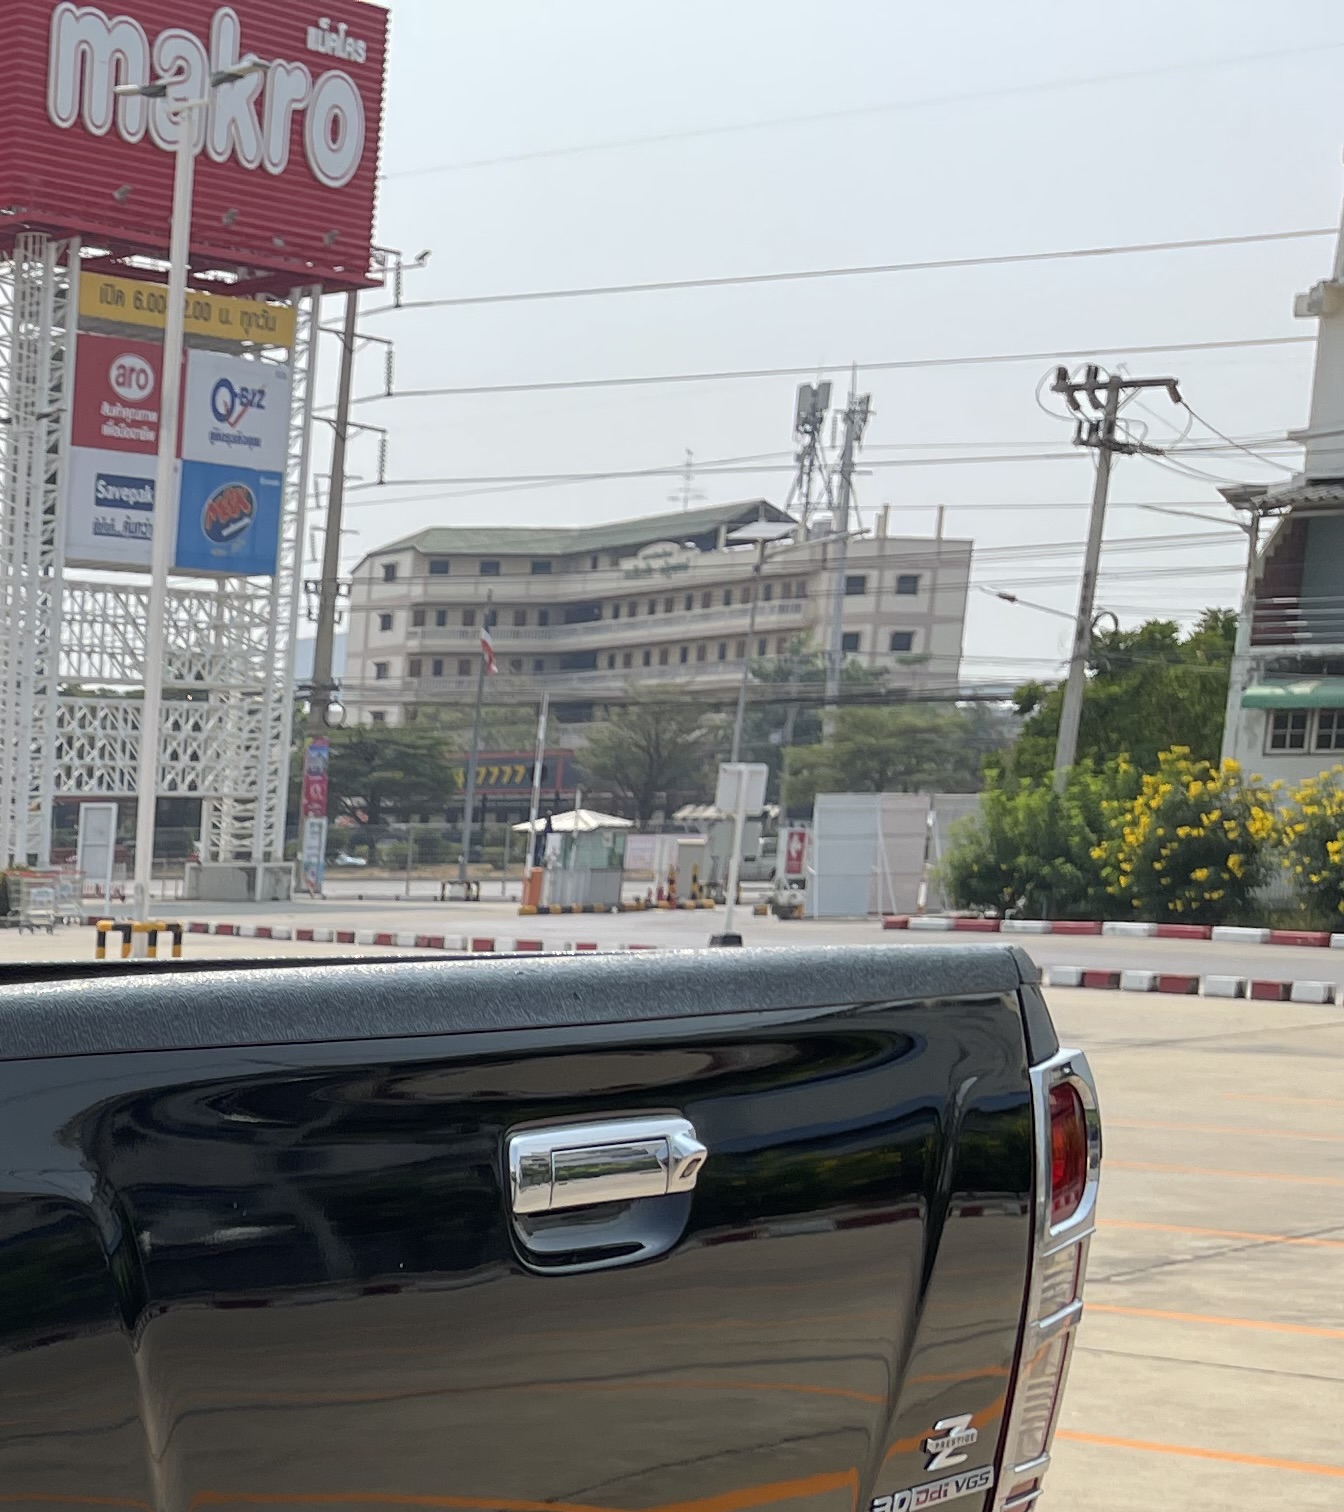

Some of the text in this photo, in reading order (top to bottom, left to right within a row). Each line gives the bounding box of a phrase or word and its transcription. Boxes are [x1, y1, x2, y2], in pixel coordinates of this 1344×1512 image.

[47, 1, 365, 188] makro
[115, 363, 149, 390] aro
[955, 1470, 991, 1495] VGS
